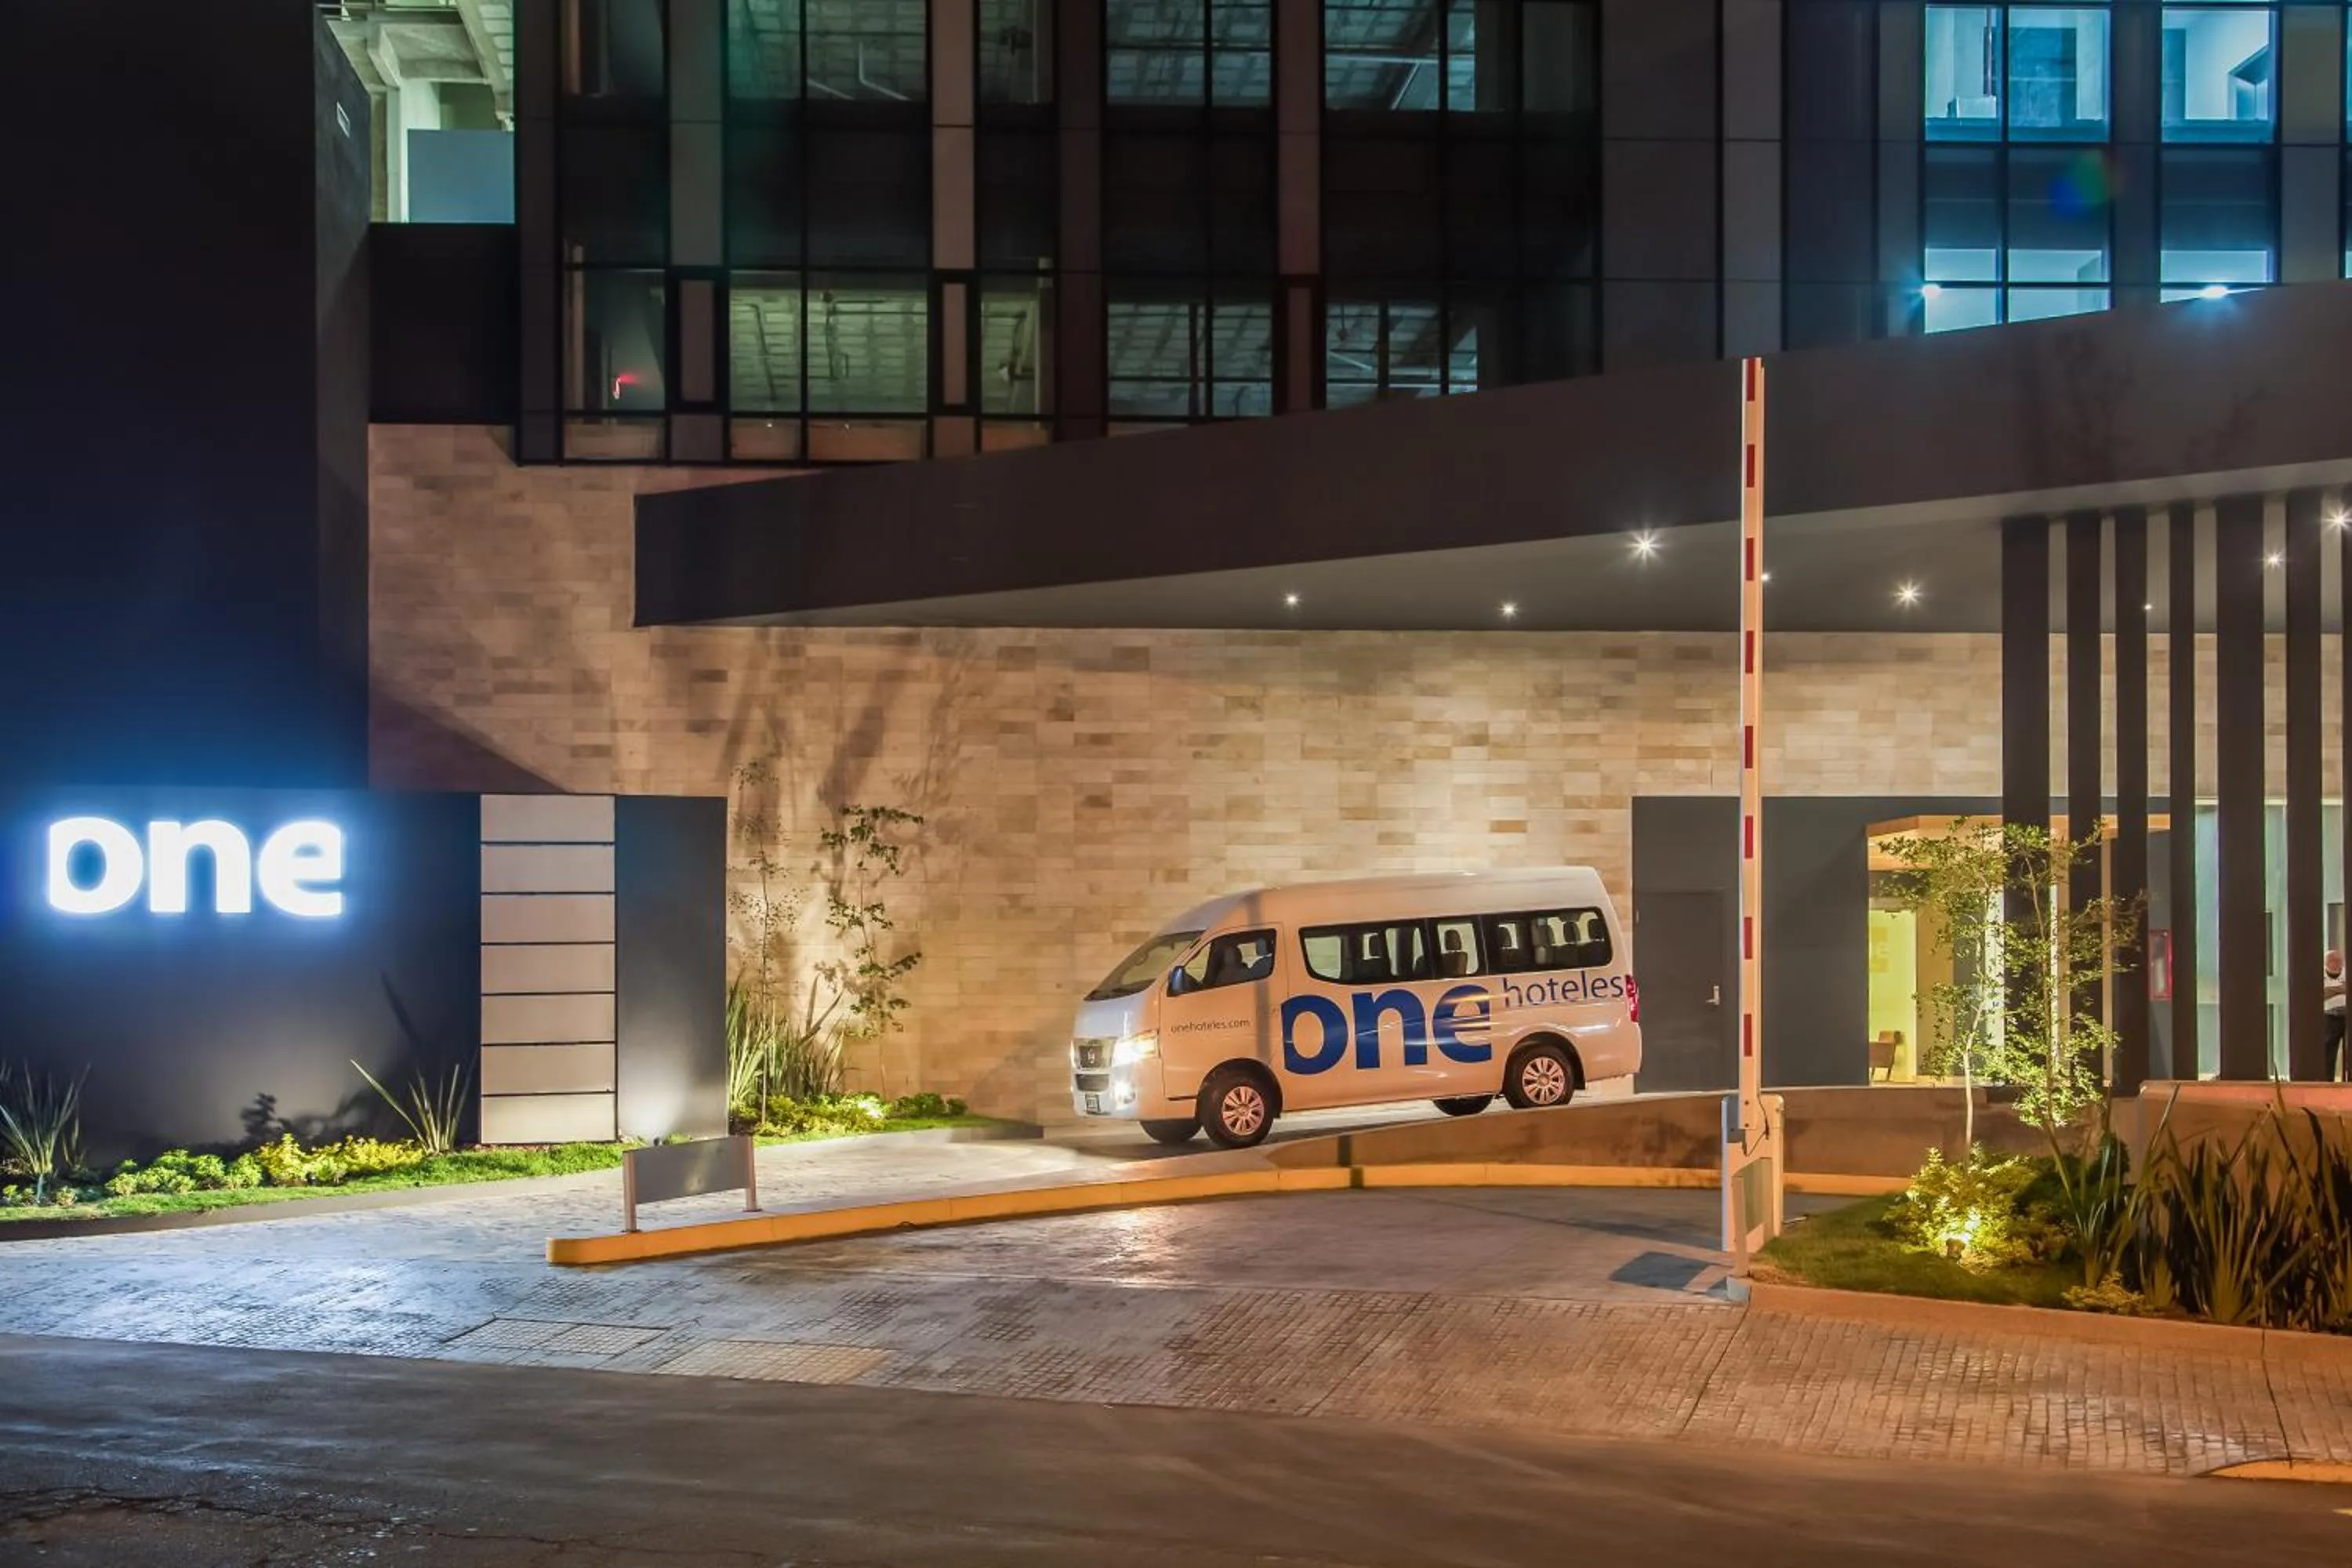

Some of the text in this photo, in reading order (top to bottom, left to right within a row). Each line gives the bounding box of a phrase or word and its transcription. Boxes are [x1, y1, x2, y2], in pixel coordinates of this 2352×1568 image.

[49, 815, 342, 916] one
[1280, 971, 1624, 1075] one hoteles
